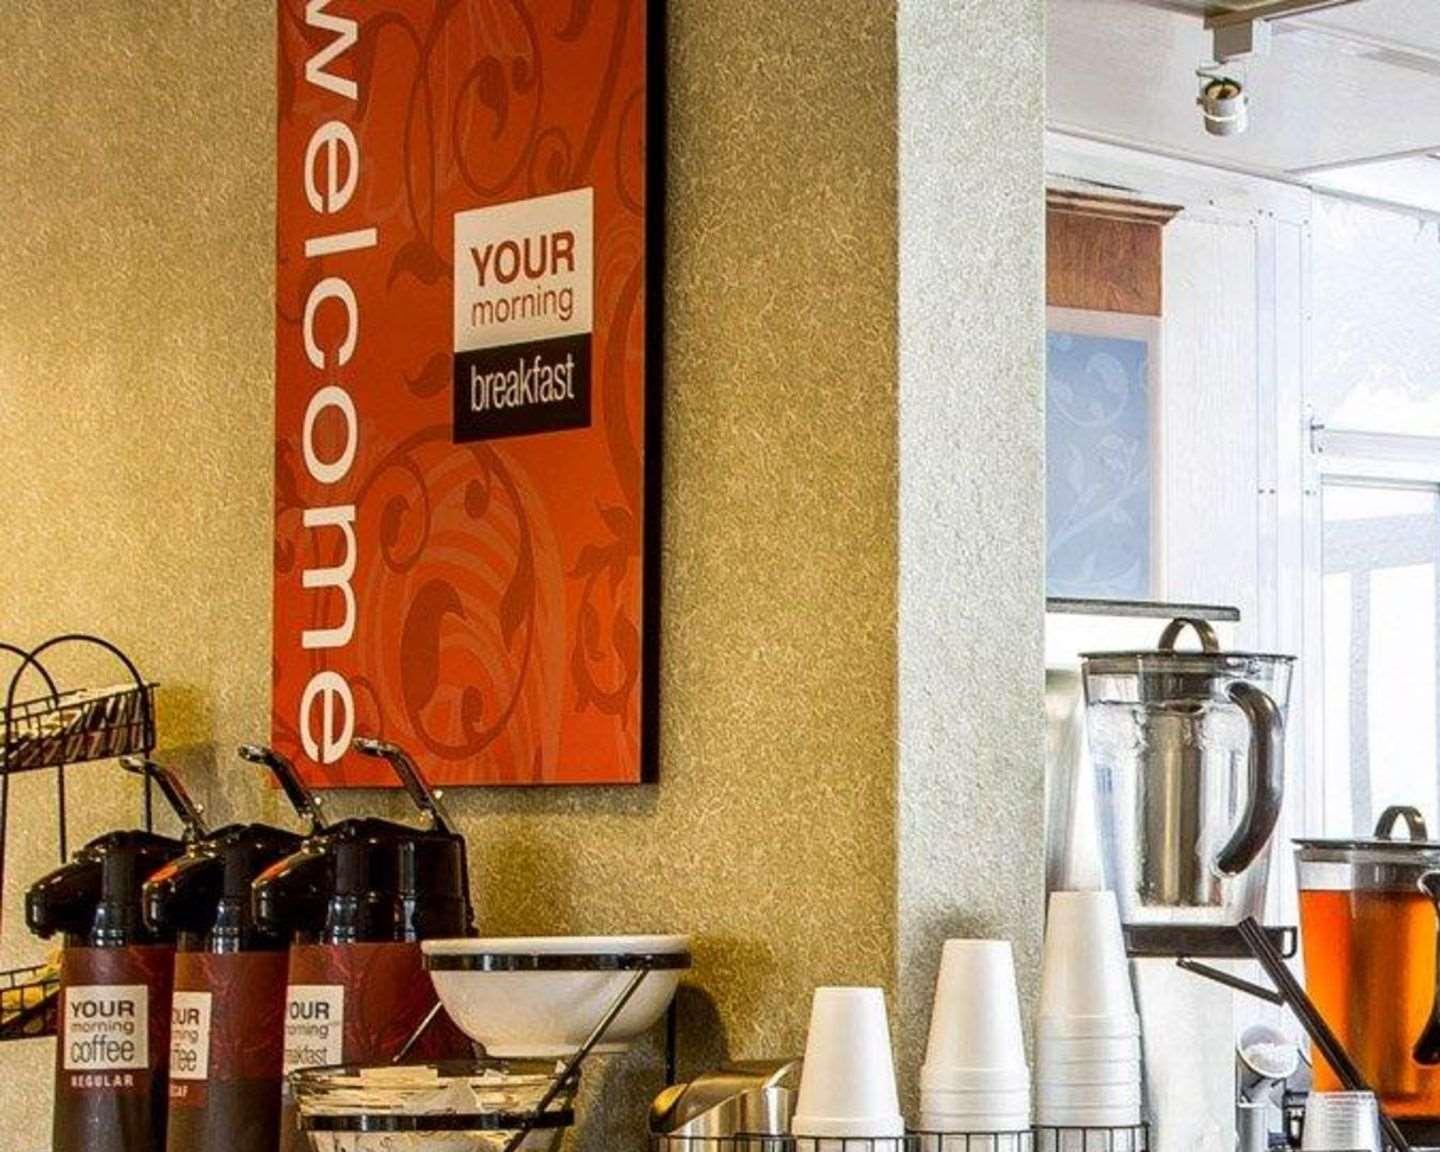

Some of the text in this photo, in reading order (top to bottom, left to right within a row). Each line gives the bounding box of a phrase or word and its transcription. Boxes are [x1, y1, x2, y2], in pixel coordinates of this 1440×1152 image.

[470, 230, 575, 288] YOUR
[471, 284, 574, 327] morning
[301, 0, 378, 765] welcome
[470, 352, 575, 412] breakfast
[71, 1000, 135, 1018] YOUR
[289, 1001, 330, 1020] OUR
[71, 1019, 135, 1036] morning
[71, 1033, 135, 1064] coffee
[71, 1073, 134, 1089] REGULAR
